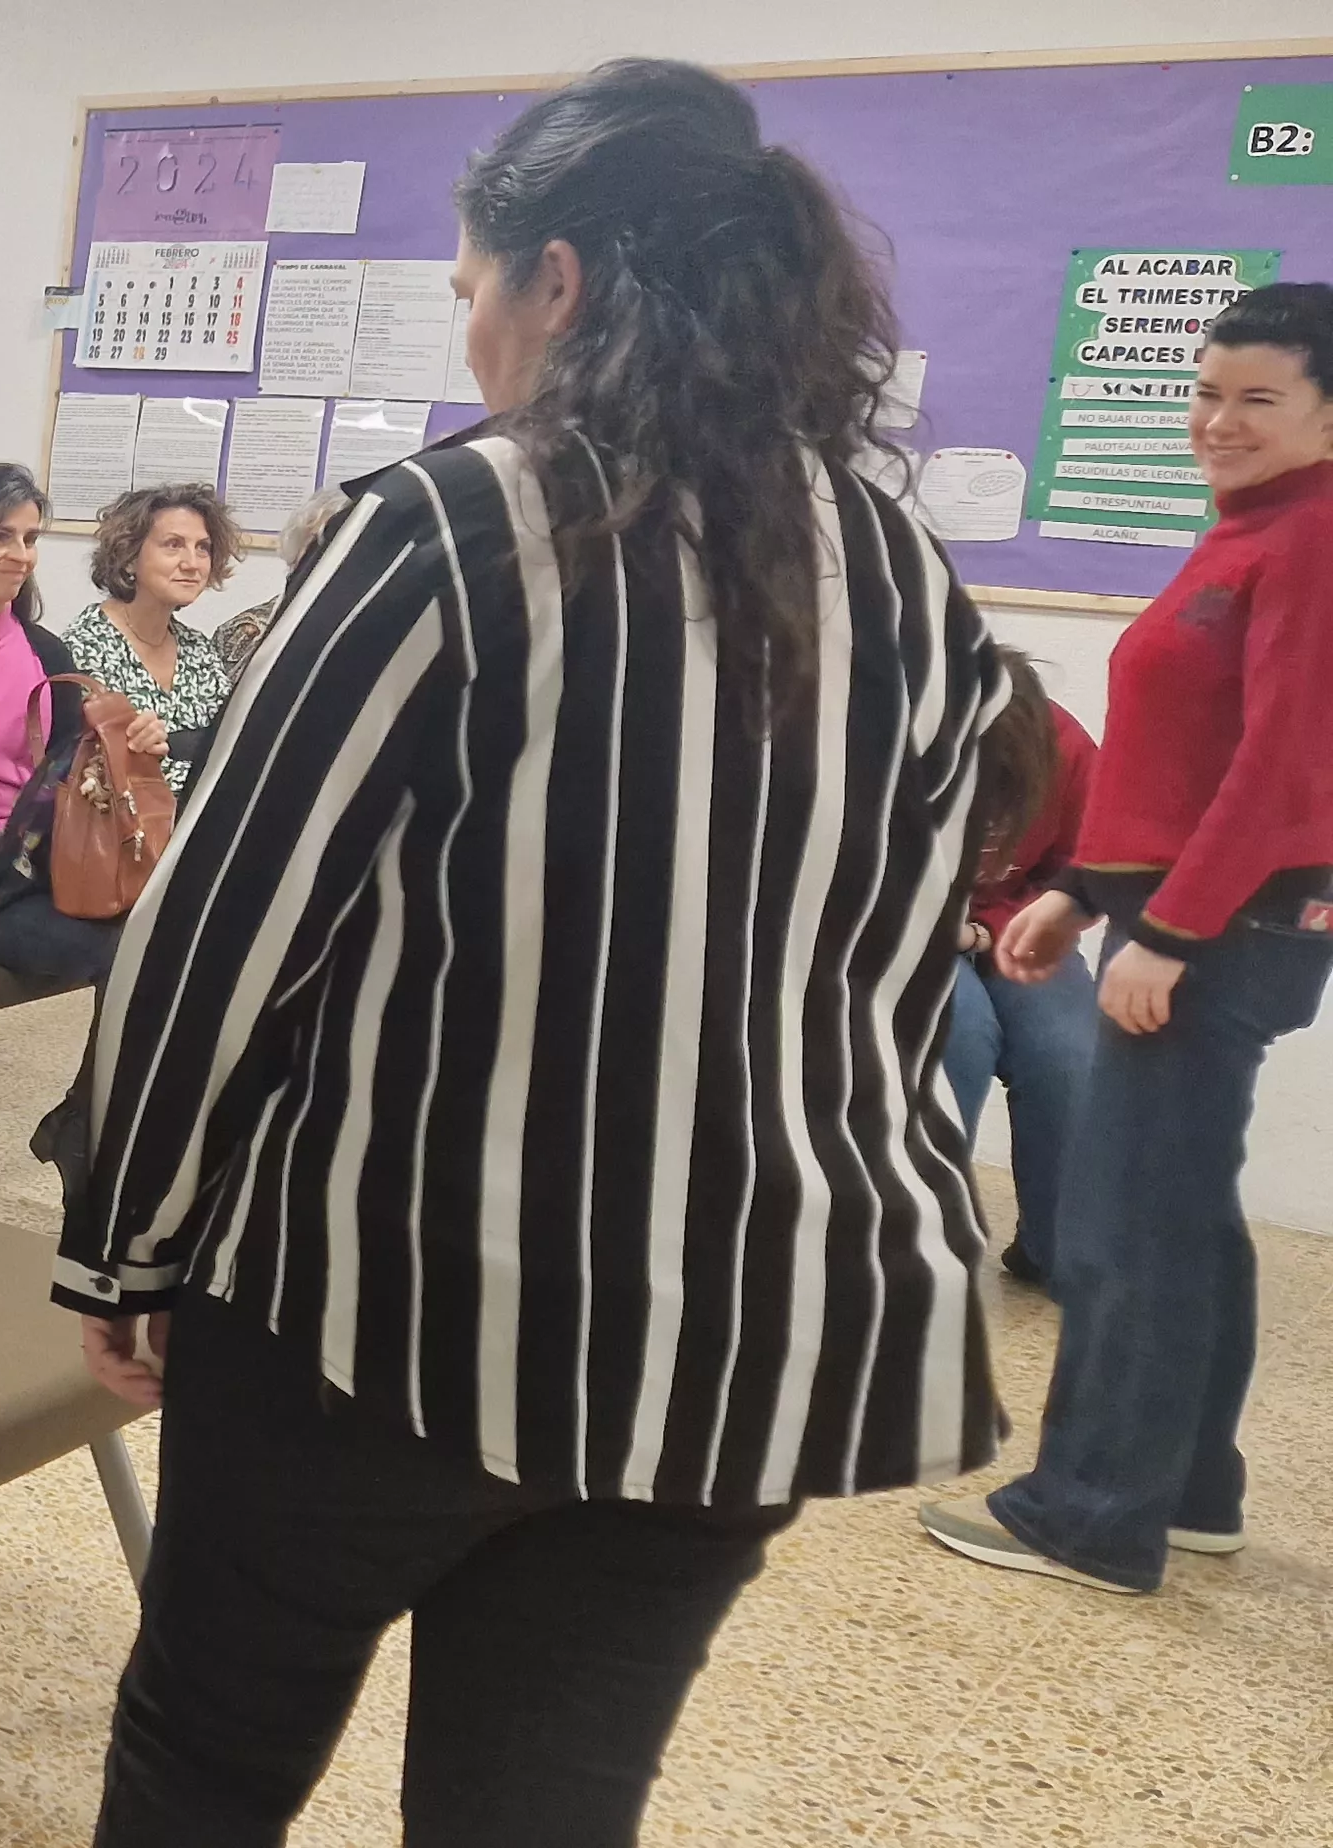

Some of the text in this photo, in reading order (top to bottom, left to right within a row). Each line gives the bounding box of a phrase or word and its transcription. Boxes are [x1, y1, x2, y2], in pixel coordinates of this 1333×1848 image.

[1251, 125, 1312, 153] B2:
[117, 153, 258, 195] 2024
[155, 249, 199, 257] FEBRERO
[1101, 260, 1233, 275] AL ACABAR
[169, 277, 243, 289] 1 2 3 4
[98, 294, 242, 308] 5 6 7 8 9 10 11
[1082, 288, 1108, 303] EL
[95, 312, 240, 326] 12 13 14 15 16 17 18
[93, 329, 238, 344] 19 20 21 22 23 24 25
[89, 346, 167, 360] 26 27 28 29
[1081, 346, 1185, 363] CAPACES
[1078, 414, 1189, 424] NO BAJAR LOS BRAZ
[1085, 442, 1141, 450] PALOTEAU
[1061, 465, 1130, 477] SEGUIDILLAS
[1134, 469, 1148, 477] DE
[1095, 498, 1171, 510] TRESPUNTIAU
[1093, 529, 1139, 540] ALCAÑIZ
